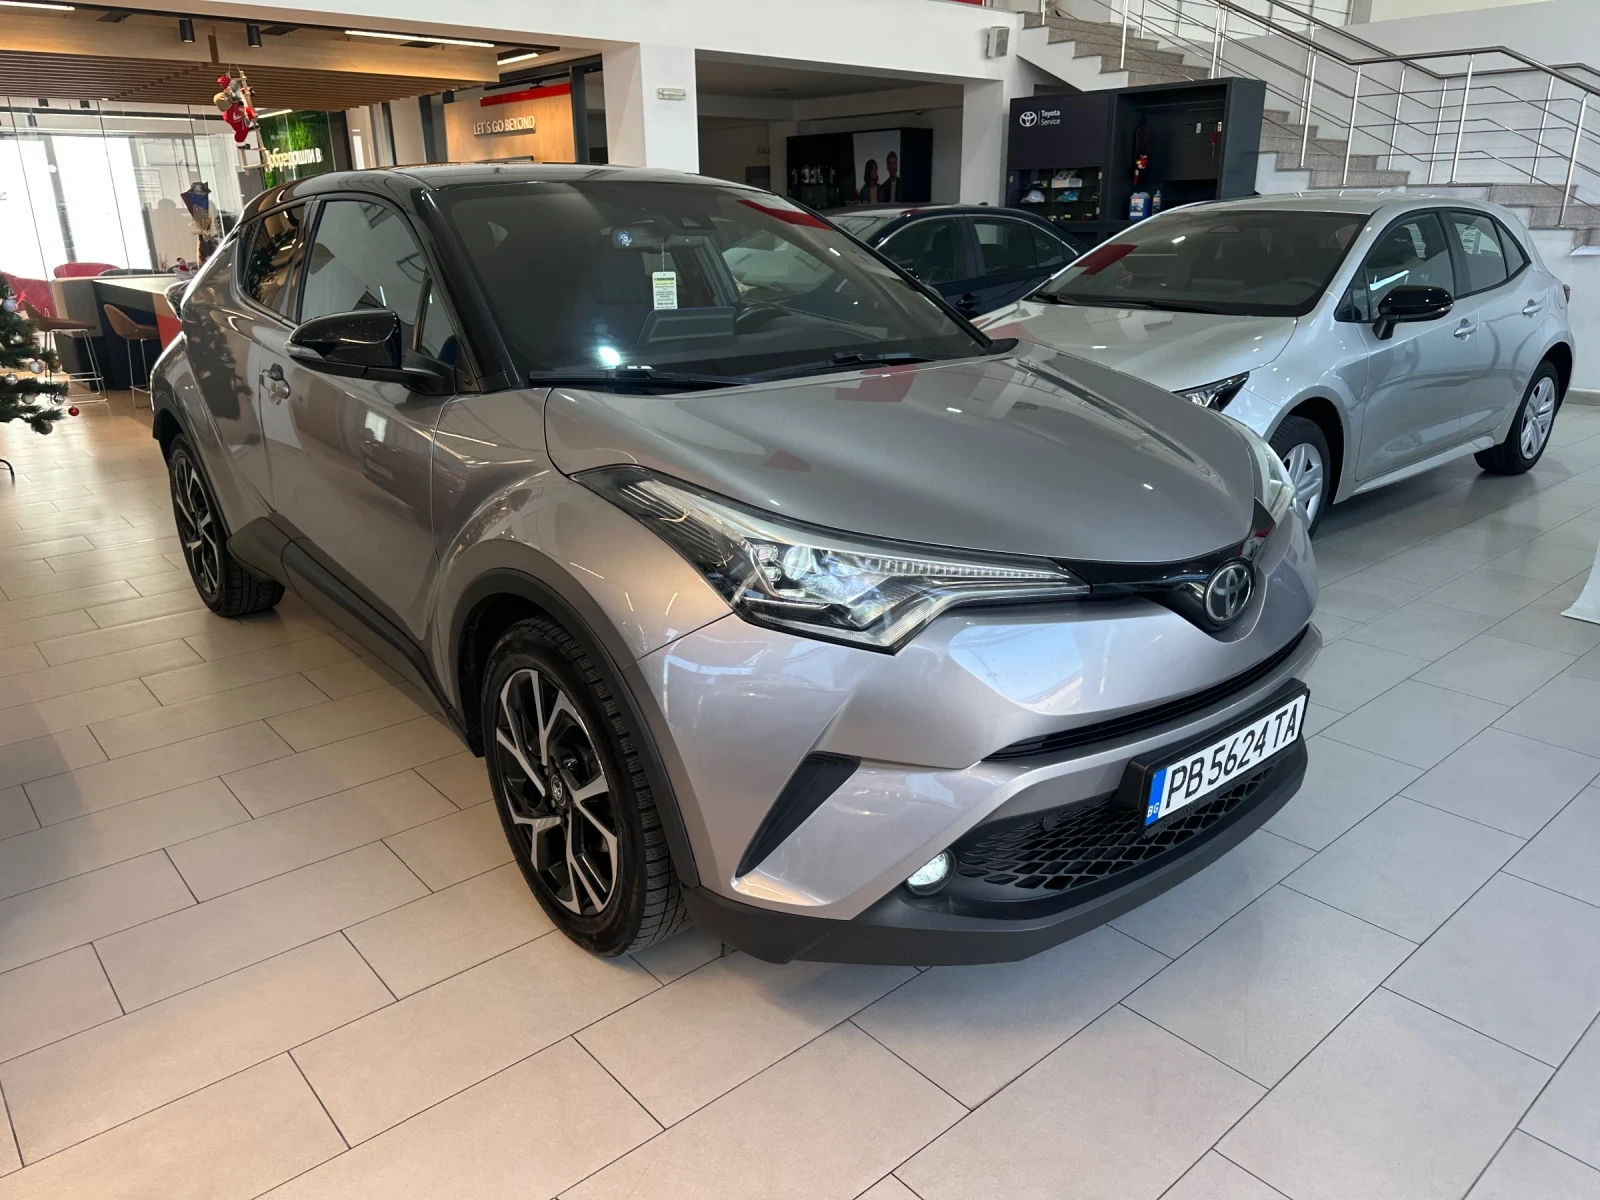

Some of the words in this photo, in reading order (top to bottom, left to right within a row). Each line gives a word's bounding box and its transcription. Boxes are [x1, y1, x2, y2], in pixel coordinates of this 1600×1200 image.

[1040, 109, 1061, 119] Toyota
[1040, 118, 1061, 126] Service
[492, 120, 504, 133] GO
[504, 115, 535, 132] BEYOND
[1165, 757, 1205, 809] PB
[1207, 720, 1270, 786] 5624
[1275, 703, 1298, 748] TA
[1147, 802, 1160, 818] BG
